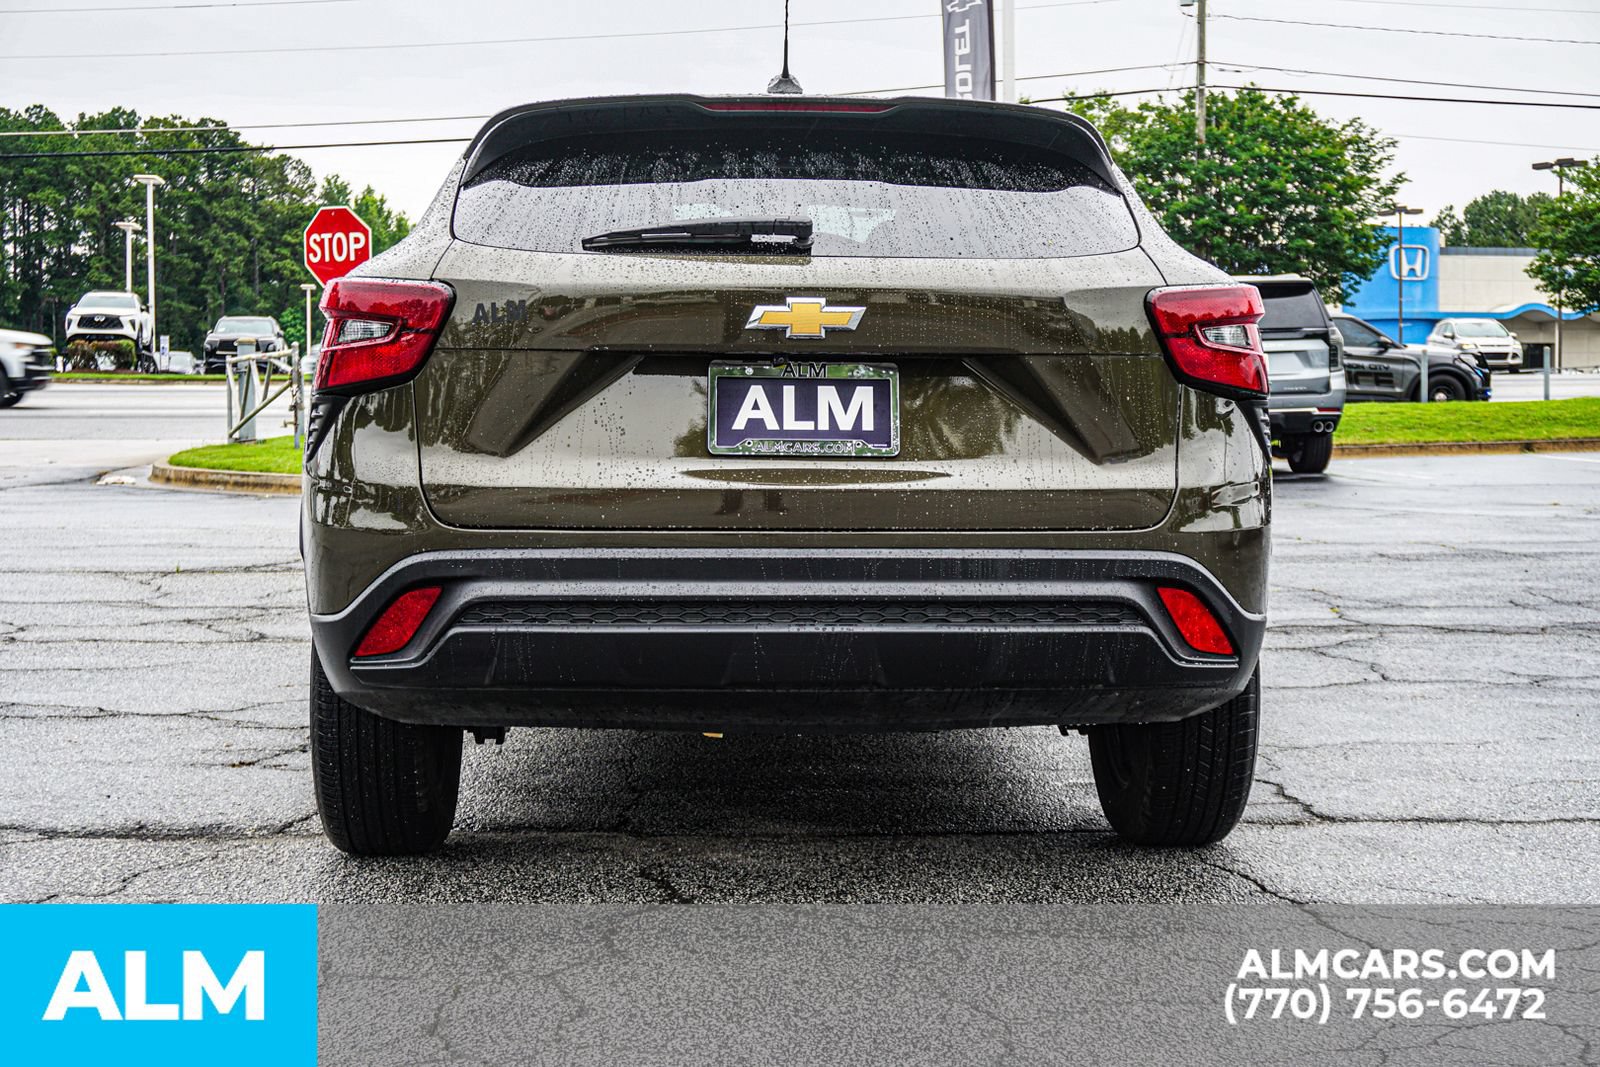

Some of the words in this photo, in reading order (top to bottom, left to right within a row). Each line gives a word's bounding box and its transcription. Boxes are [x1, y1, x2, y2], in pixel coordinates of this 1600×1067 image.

[308, 231, 366, 264] STOP
[471, 299, 529, 327] ALM
[780, 362, 828, 378] ALM
[731, 384, 875, 432] ALM
[753, 440, 857, 454] ALMCARS.COM
